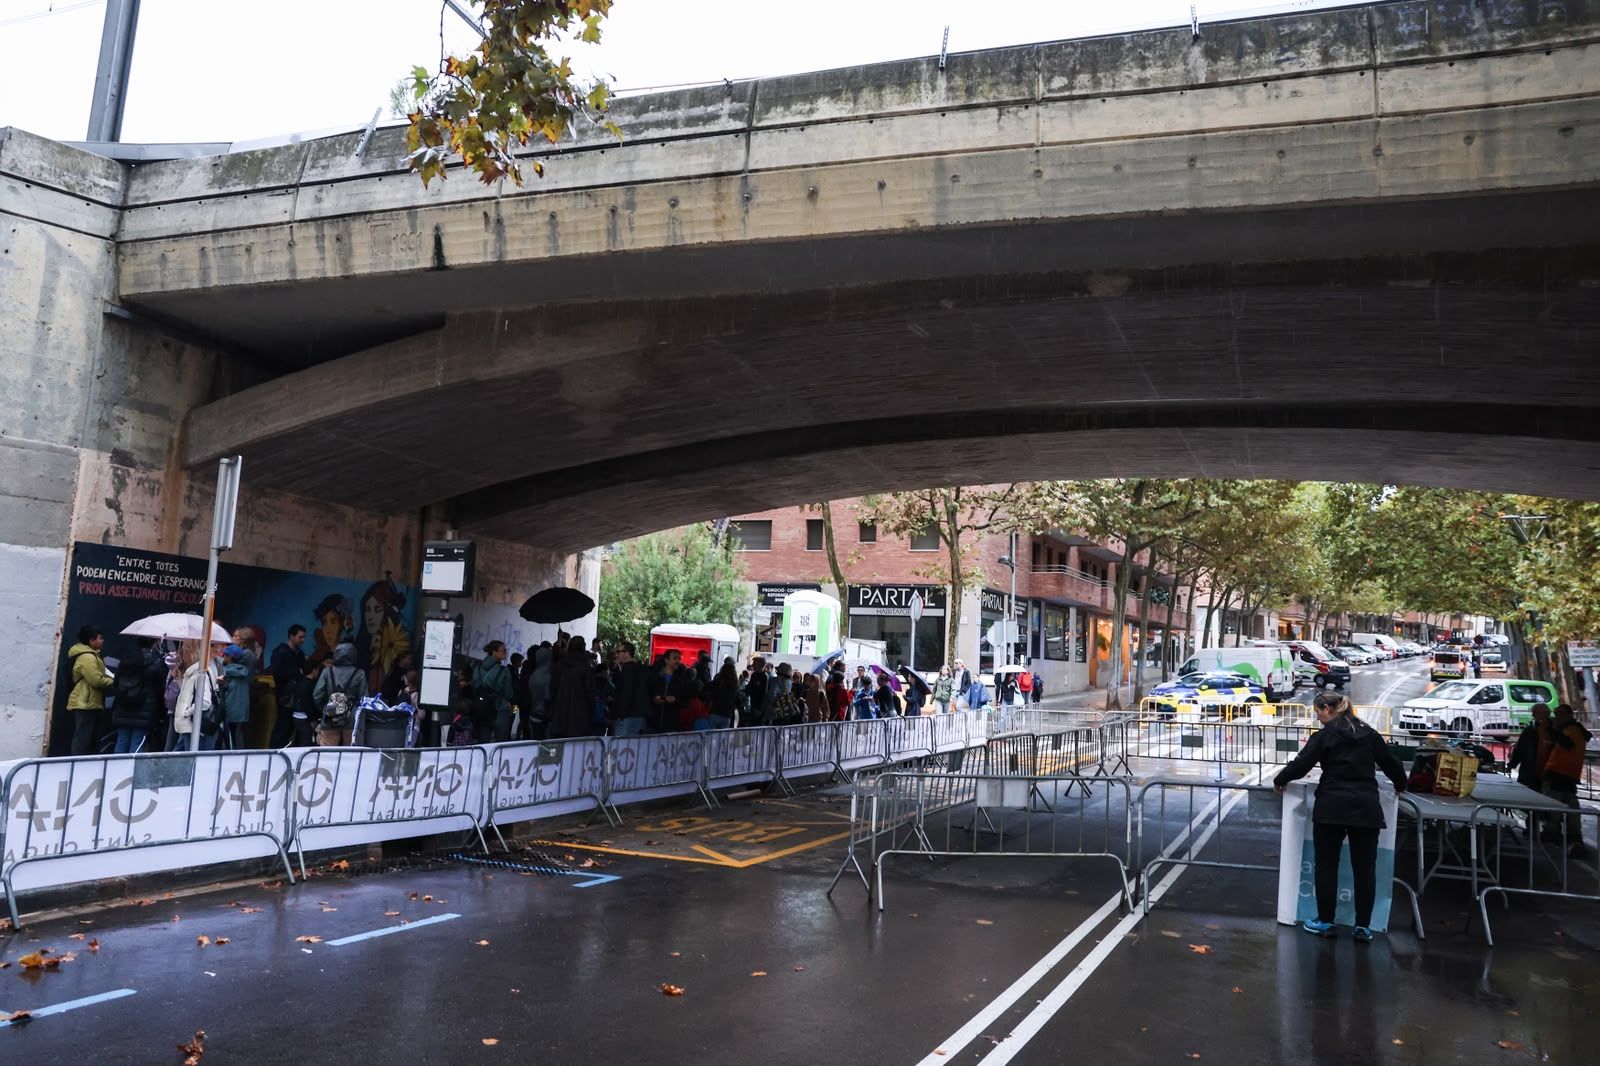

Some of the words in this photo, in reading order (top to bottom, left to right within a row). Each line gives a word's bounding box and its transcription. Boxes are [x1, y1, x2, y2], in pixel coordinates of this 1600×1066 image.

[76, 565, 106, 579] PODEM
[108, 569, 157, 585] ENCENDRE
[156, 562, 179, 573] TOTES
[79, 582, 106, 596] PROU
[108, 585, 172, 601] ASSETJAMENT
[859, 588, 935, 607] PARTAL
[982, 591, 1003, 611] PARTAL
